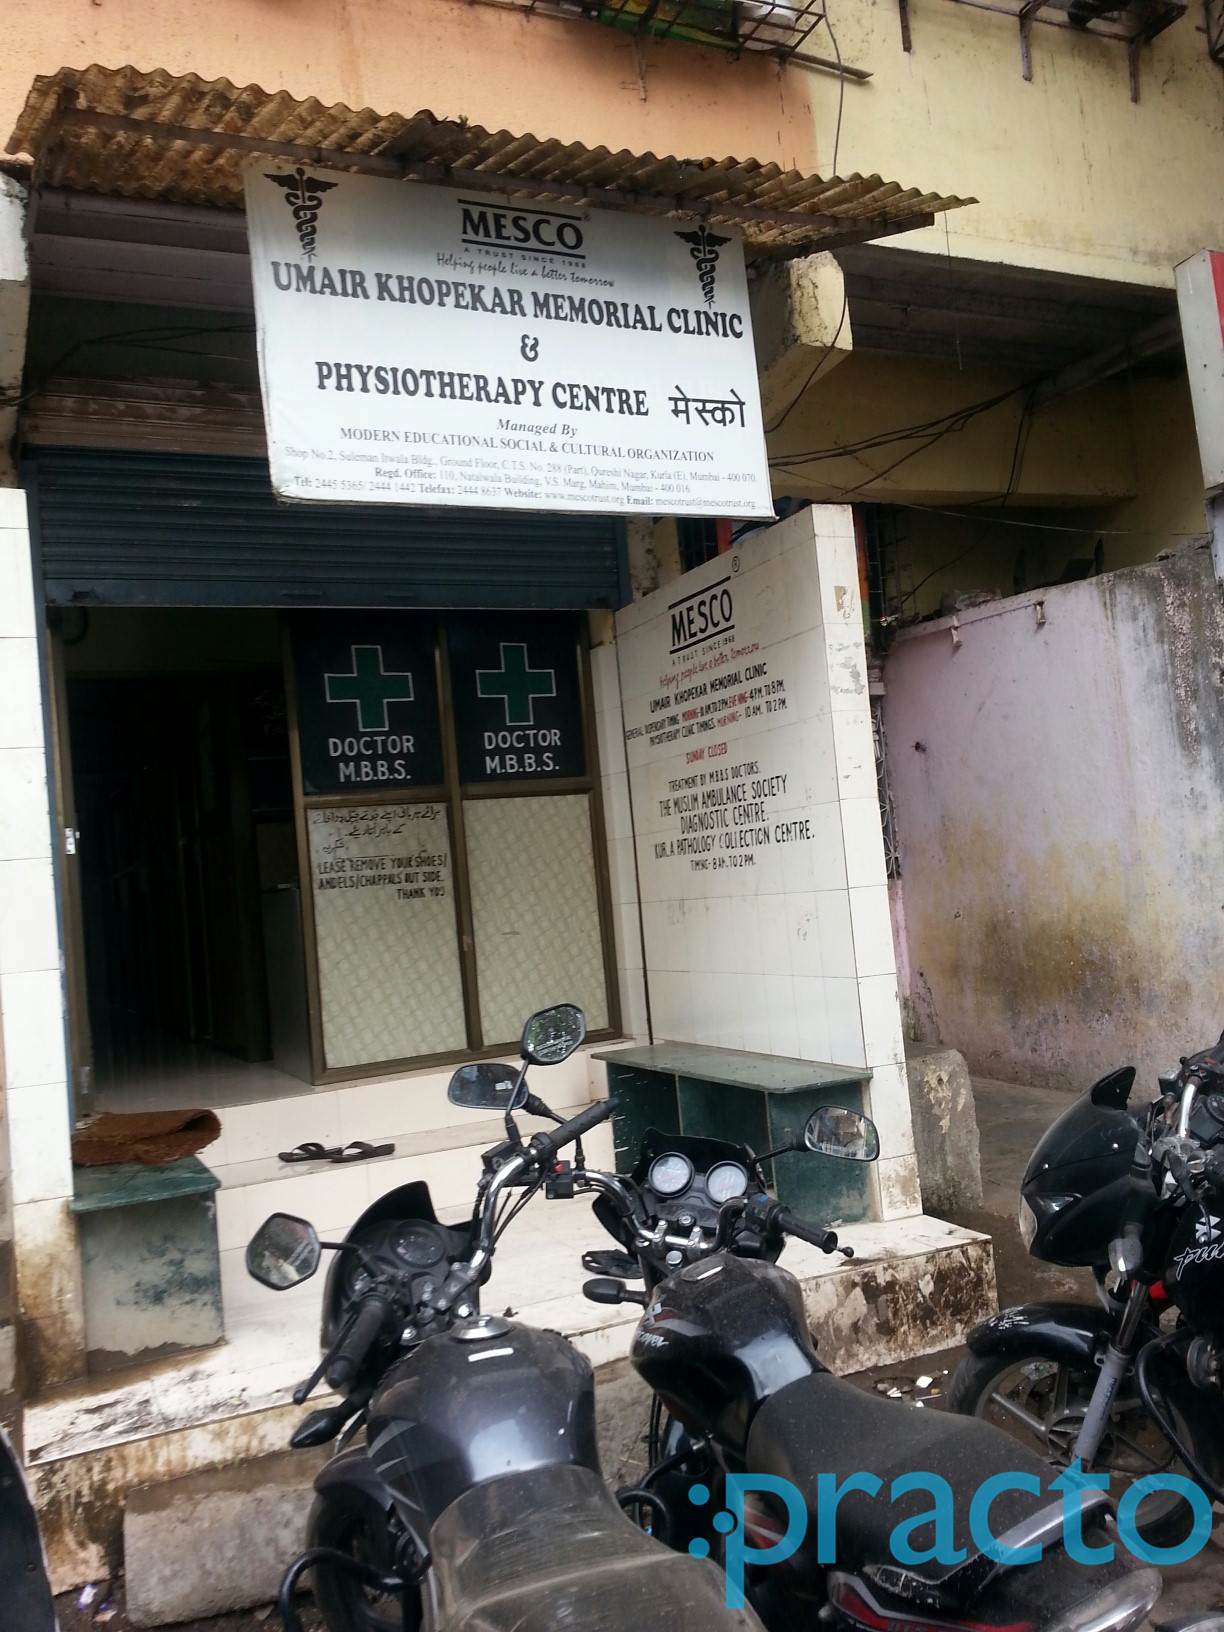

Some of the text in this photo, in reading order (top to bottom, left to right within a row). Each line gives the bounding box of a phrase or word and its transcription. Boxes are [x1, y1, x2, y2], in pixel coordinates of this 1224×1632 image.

[462, 208, 583, 250] MESCO
[437, 252, 474, 273] Helping
[478, 261, 506, 276] people
[541, 266, 567, 281] better
[270, 261, 743, 340] UMAIR KHOPEKAR MEMORIAL CLINIC
[520, 335, 540, 362] &
[315, 362, 649, 416] PHYSIOTHERAPY CENTRE
[668, 385, 747, 429] मेस्को
[497, 418, 578, 439] Managed By
[340, 427, 714, 462] MODERN EDUCATIONAL SOCIAL & CULTURAL ORGANIZATION
[404, 467, 437, 480] Office:
[504, 487, 542, 499] Website:
[627, 495, 653, 506] Email:
[671, 588, 733, 646] MESCO
[650, 695, 671, 713] UMAIR
[674, 682, 707, 705] KHOPEKAR
[709, 671, 742, 694] MEMORIAL
[745, 662, 768, 681] CLINIC
[328, 735, 415, 757] DOCTOR
[484, 729, 561, 750] DOCTOR
[708, 742, 728, 758] CLOSED
[338, 760, 412, 783] M.B.B.S.
[485, 753, 560, 774] M.B.B.S.
[668, 775, 698, 793] TREATMENT
[700, 773, 707, 786] BY
[659, 774, 788, 818] THE MUSLIM AMBULANCE SOCIETY
[681, 810, 729, 835] DIAGNOSTIC
[676, 834, 717, 856] PATHOLOGY
[739, 854, 744, 867] 2
